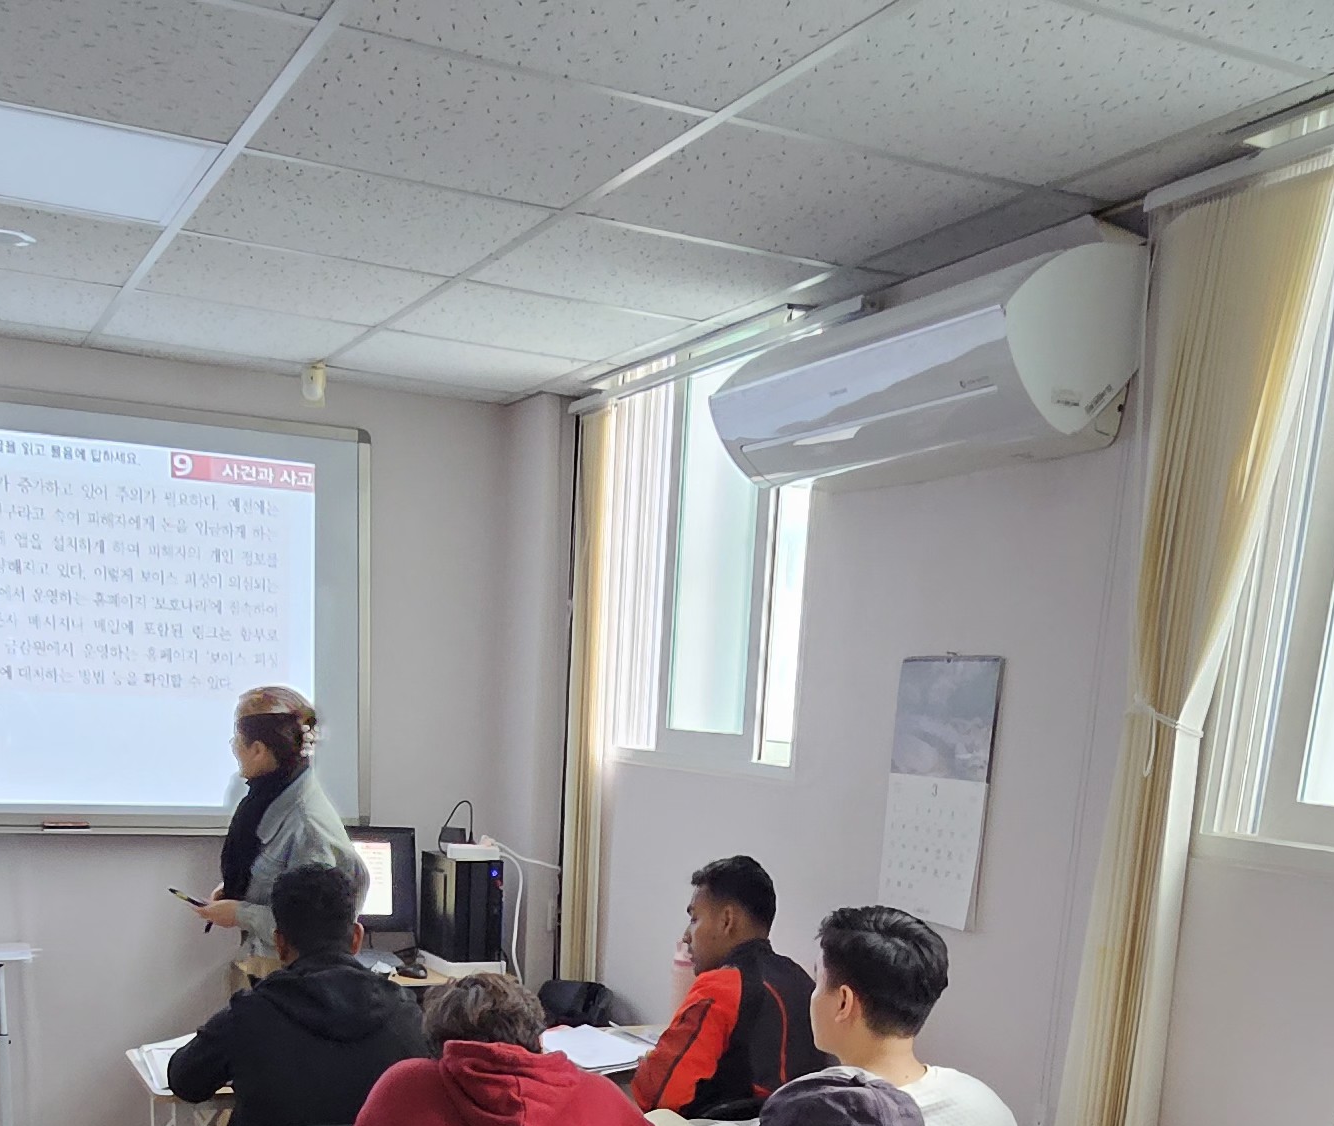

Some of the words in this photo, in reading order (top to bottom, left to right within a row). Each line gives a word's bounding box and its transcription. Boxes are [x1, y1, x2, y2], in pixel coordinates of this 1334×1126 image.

[21, 441, 44, 456] 읽고
[50, 444, 86, 461] 물음에
[90, 448, 140, 466] 답하세요.
[173, 454, 192, 477] 9
[221, 463, 272, 483] 사건과
[280, 469, 311, 487] 사고
[16, 476, 73, 497] 증가하고
[80, 482, 107, 500] 있어
[115, 485, 156, 504] 주의가
[87, 510, 154, 532] 피해자에게
[53, 535, 104, 554] 설치하게
[148, 543, 200, 560] 피해자의
[210, 547, 233, 564] 개인
[242, 550, 277, 568] 정보를
[56, 562, 85, 580] 있다.
[93, 564, 133, 583] 이렇게
[140, 569, 177, 586] 보이스
[184, 570, 221, 589] 피싱이
[32, 587, 81, 605] 운영하는
[92, 591, 146, 609] 홈페이지
[27, 613, 83, 632] 메시지나
[93, 618, 133, 636] 메일에
[143, 621, 183, 638] 포함된
[83, 642, 137, 661] 운영하는
[146, 646, 197, 664] 홈페이지
[78, 668, 104, 685] 방법
[143, 672, 182, 688] 확인할
